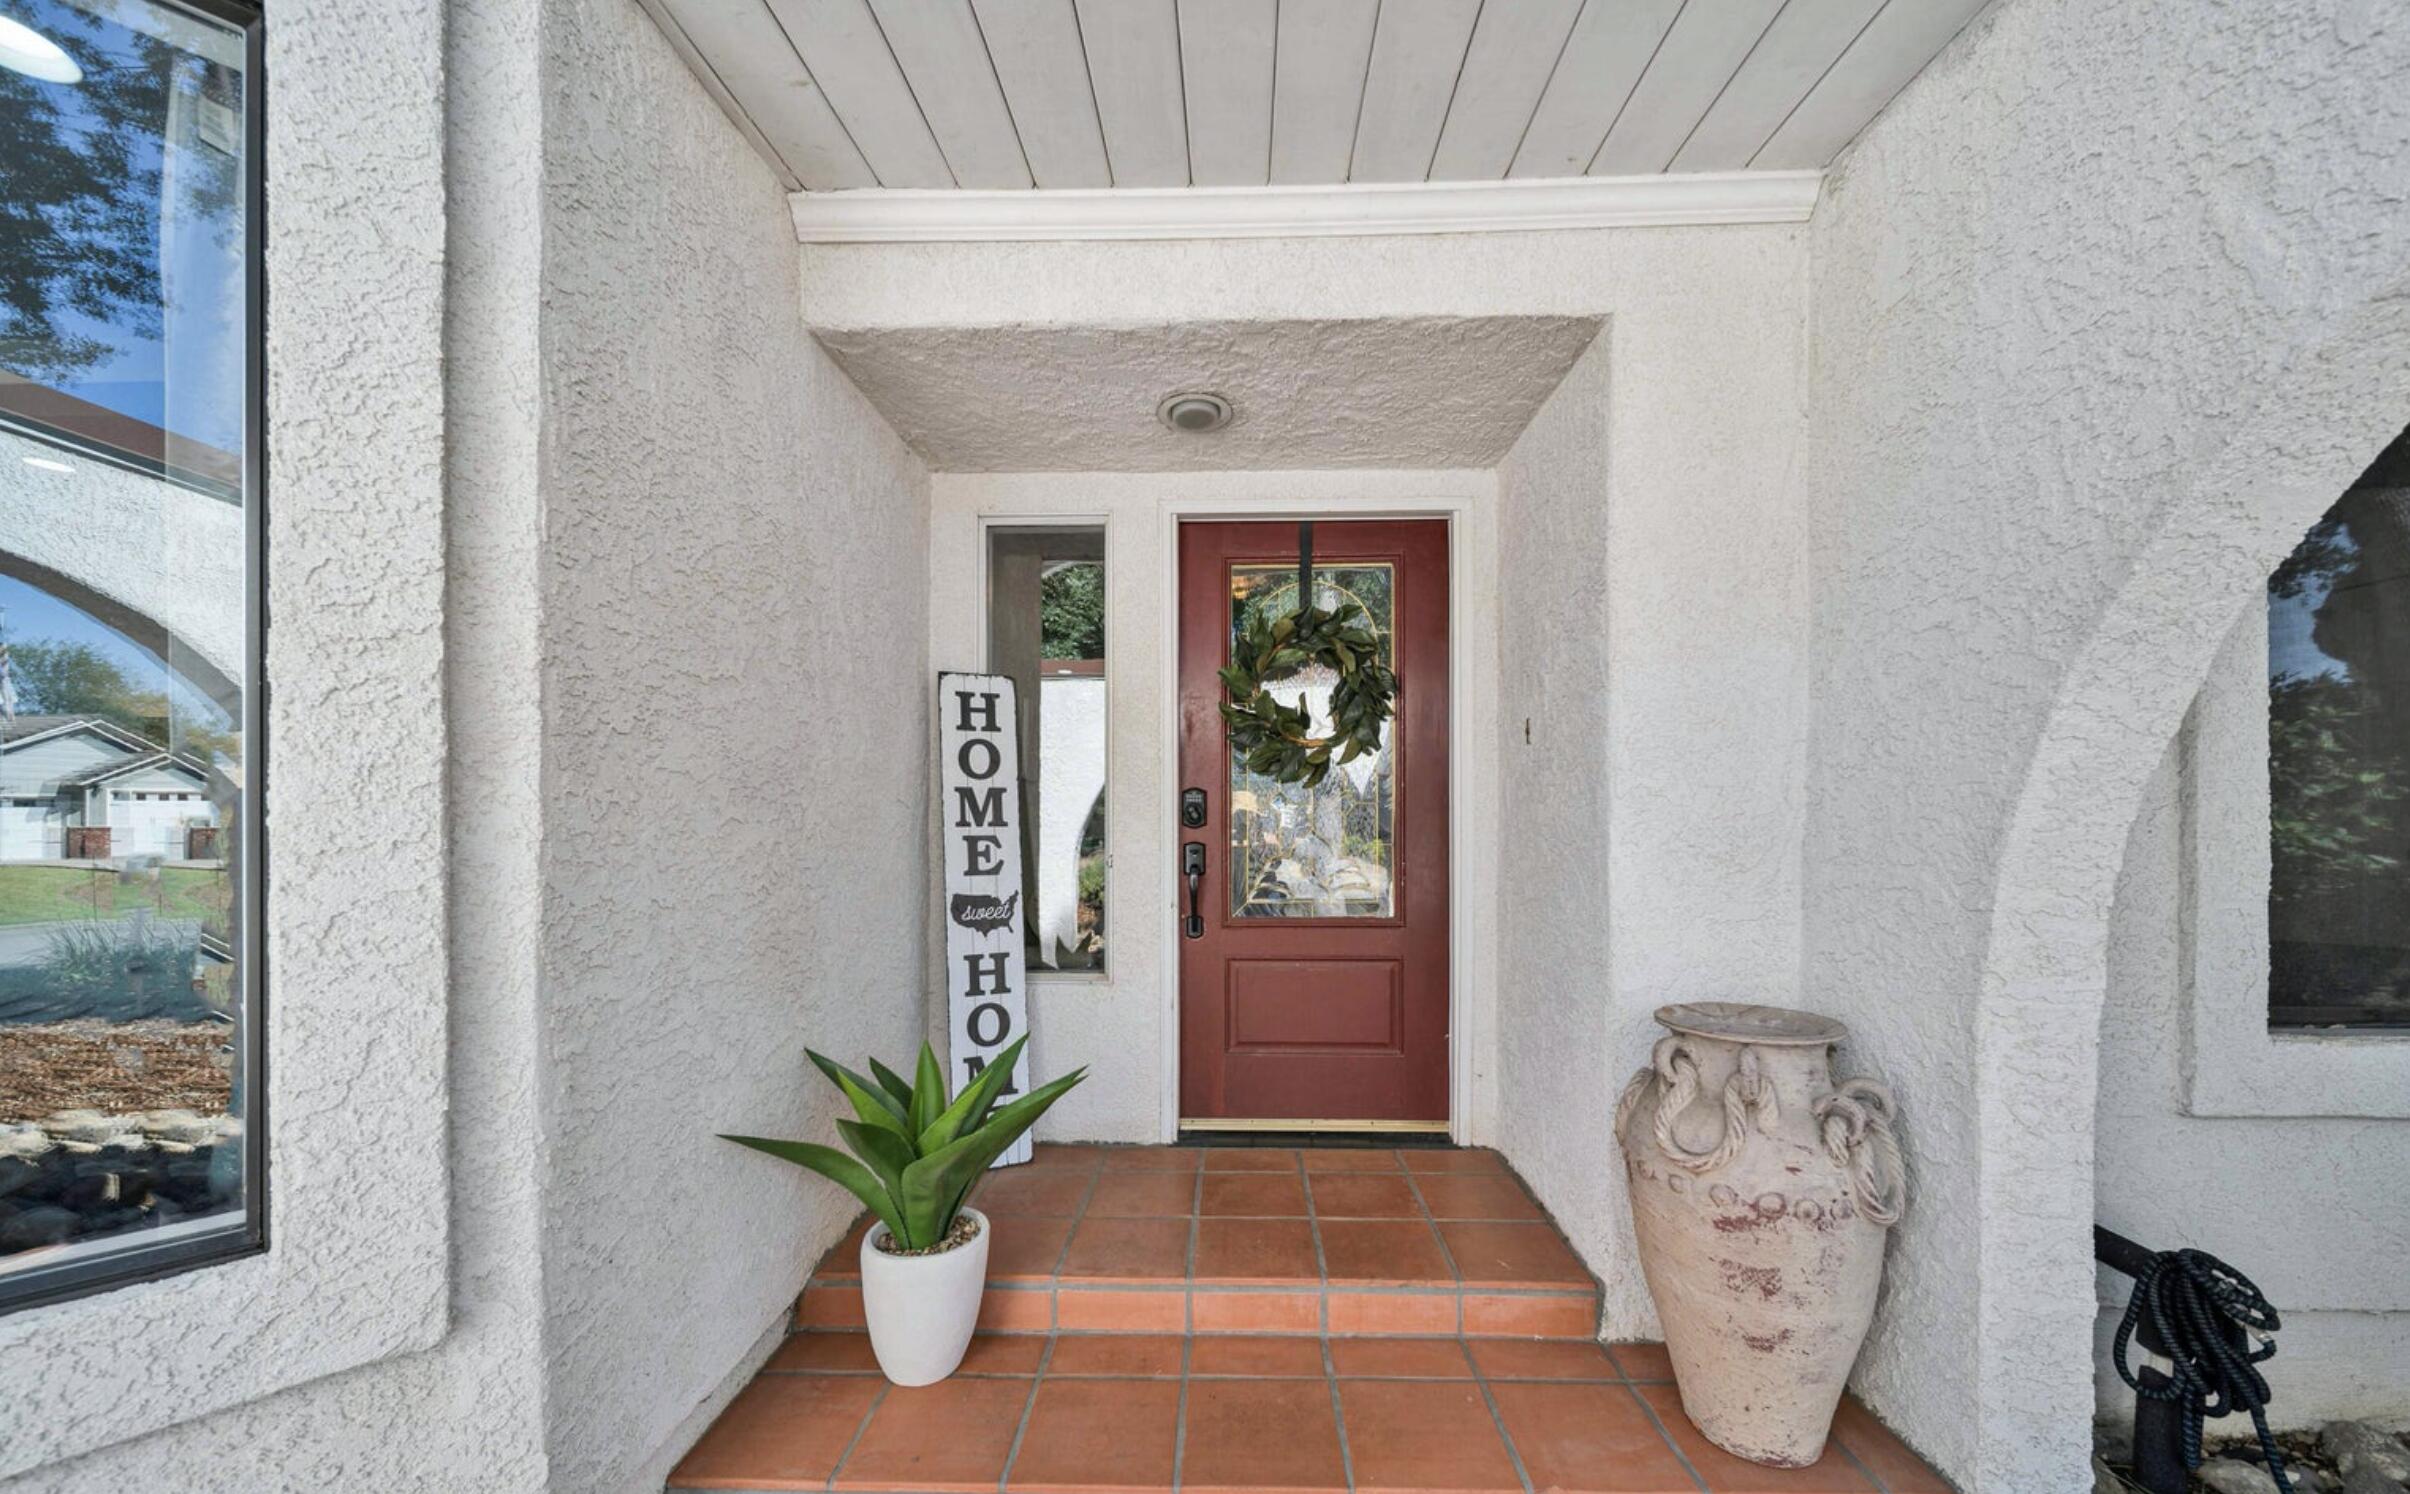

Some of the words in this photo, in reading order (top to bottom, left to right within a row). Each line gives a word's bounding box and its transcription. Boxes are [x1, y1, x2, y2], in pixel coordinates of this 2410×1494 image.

[954, 690, 1009, 877] HOME
[961, 902, 1011, 921] sweet
[963, 952, 1019, 1124] HO
